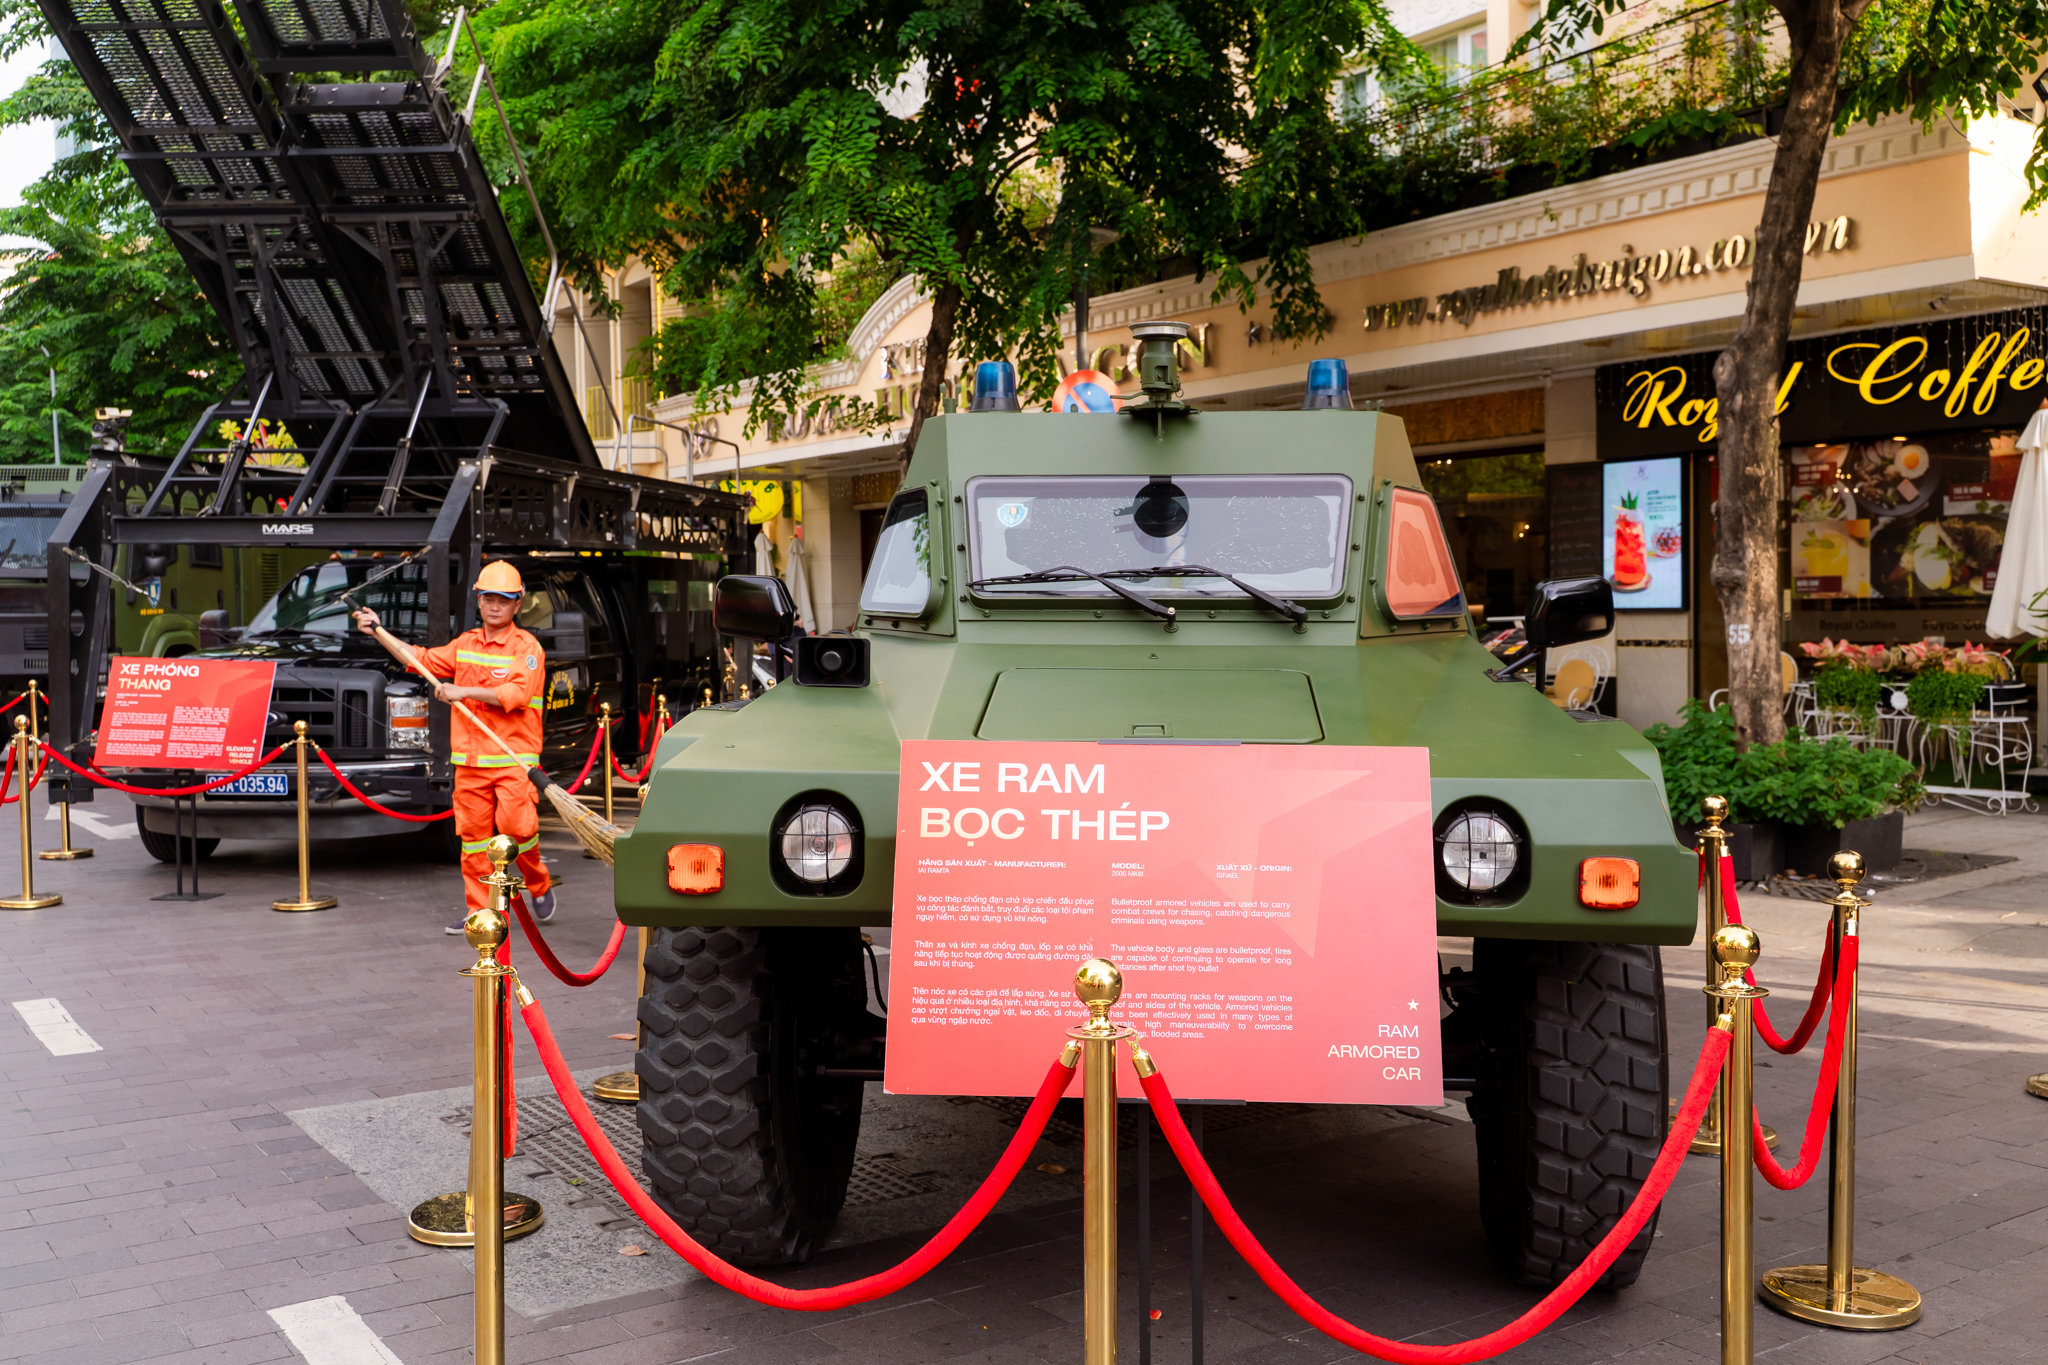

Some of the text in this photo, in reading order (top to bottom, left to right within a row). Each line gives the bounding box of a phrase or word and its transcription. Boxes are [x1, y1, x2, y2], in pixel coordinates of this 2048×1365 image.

[1623, 327, 2048, 442] Royl Coffe
[262, 524, 314, 533] MARS
[1728, 624, 1750, 645] 55
[120, 662, 200, 677] XE PHÓNG
[119, 678, 171, 690] THANG
[919, 762, 1105, 794] XE RAM
[920, 802, 1170, 846] BỌC THÉP
[1111, 898, 1153, 907] Bulletproof
[997, 905, 1012, 914] truy
[1181, 908, 1212, 918] chasing,
[1215, 908, 1248, 918] catching
[1250, 909, 1291, 919] dangerous
[1111, 916, 1145, 924] criminals
[1146, 916, 1167, 926] using
[1156, 944, 1175, 954] body
[1193, 945, 1214, 955] glass
[1230, 946, 1273, 956] bulletproof,
[1126, 953, 1157, 963] capable
[1172, 954, 1212, 964] continuing
[1227, 955, 1257, 964] operate
[1275, 955, 1292, 965] long
[1187, 964, 1196, 974] by
[1151, 992, 1186, 1002] mounting
[1194, 1002, 1223, 1010] vehicle.
[1225, 1002, 1258, 1010] Armored
[1261, 1003, 1292, 1011] vehicles
[1153, 1011, 1192, 1021] effectively
[1258, 1013, 1280, 1022] types
[1145, 1020, 1162, 1030] high
[1170, 1020, 1230, 1031] maneuverability
[1378, 1024, 1419, 1038] RAM
[1151, 1029, 1180, 1038] flooded
[1327, 1045, 1420, 1059] ARMORED
[1382, 1067, 1421, 1080] CAR
